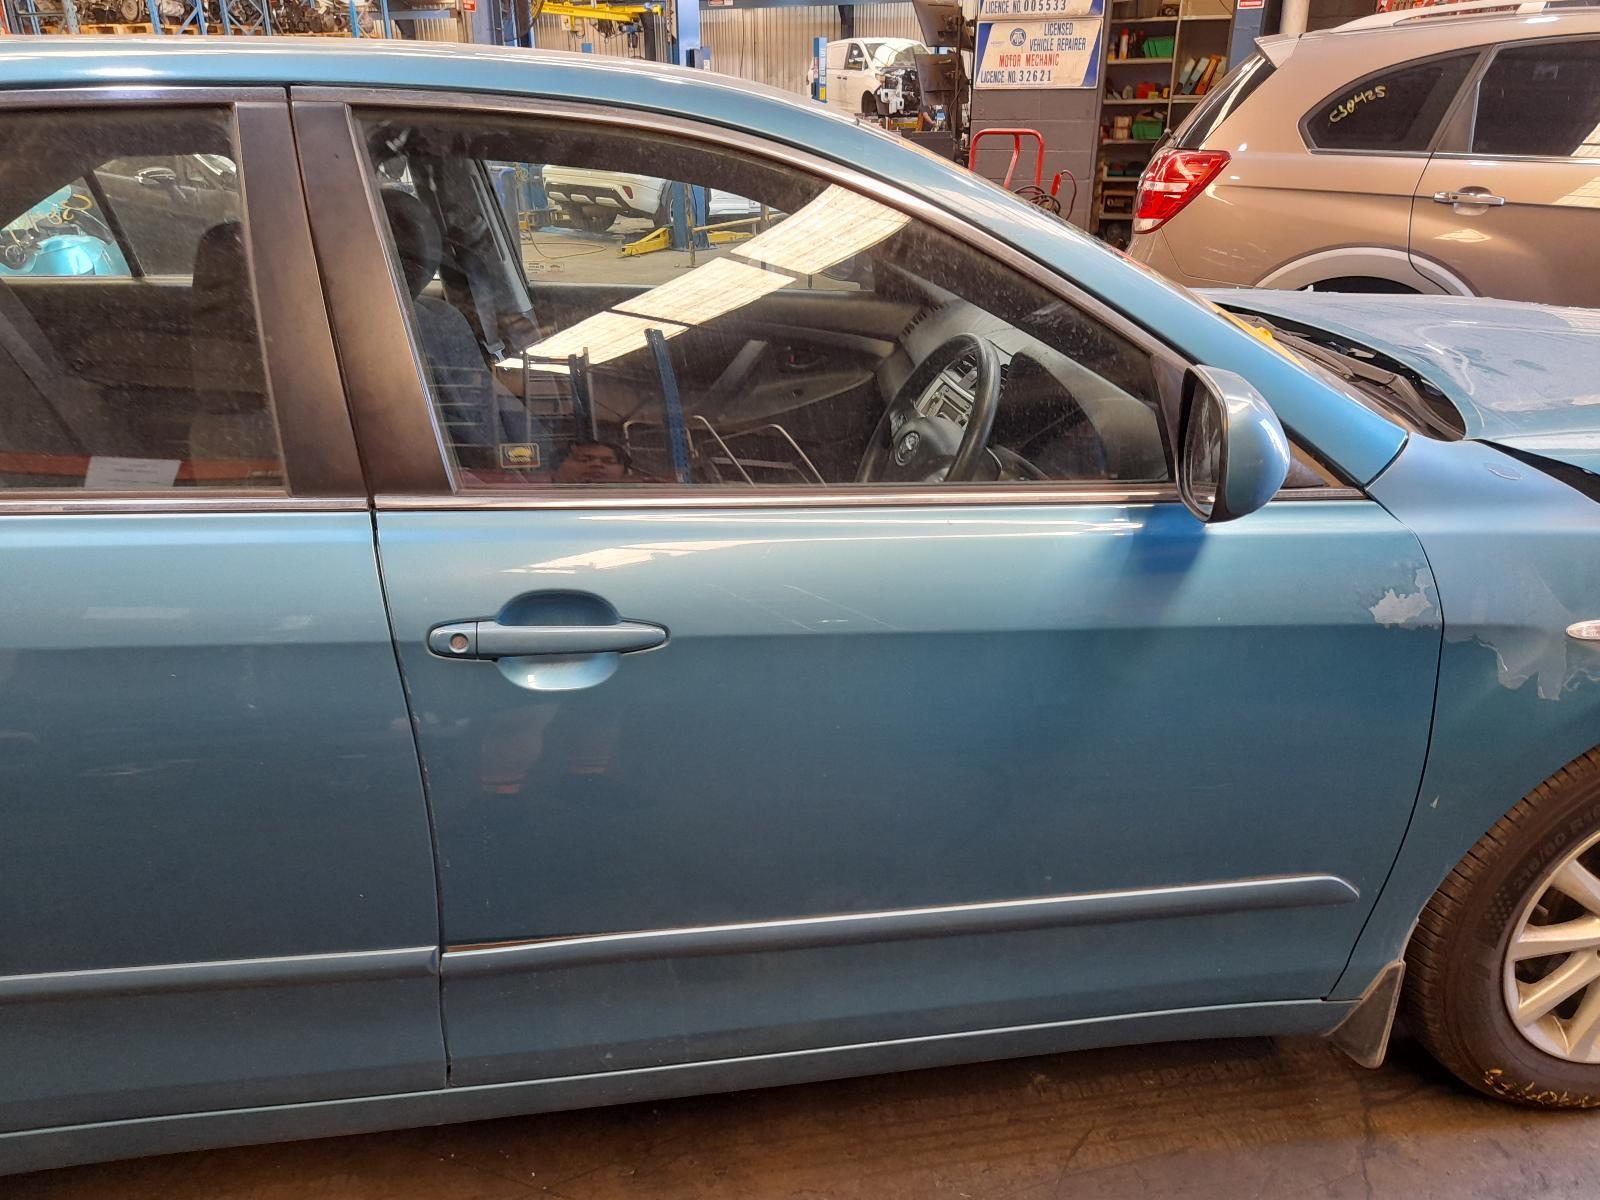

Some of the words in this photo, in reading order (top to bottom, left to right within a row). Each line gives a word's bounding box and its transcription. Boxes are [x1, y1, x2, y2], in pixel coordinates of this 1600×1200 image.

[985, 1, 1009, 14] LICENCE
[1023, 0, 1066, 11] 005533
[1044, 23, 1073, 36] LICENSED
[1029, 39, 1054, 51] VEHICLE
[1056, 38, 1086, 51] REPAIRER
[998, 55, 1021, 67] MOTOR
[1025, 53, 1060, 67] MECHANIC
[980, 70, 1005, 84] LICENCE
[1019, 70, 1052, 82] 32621
